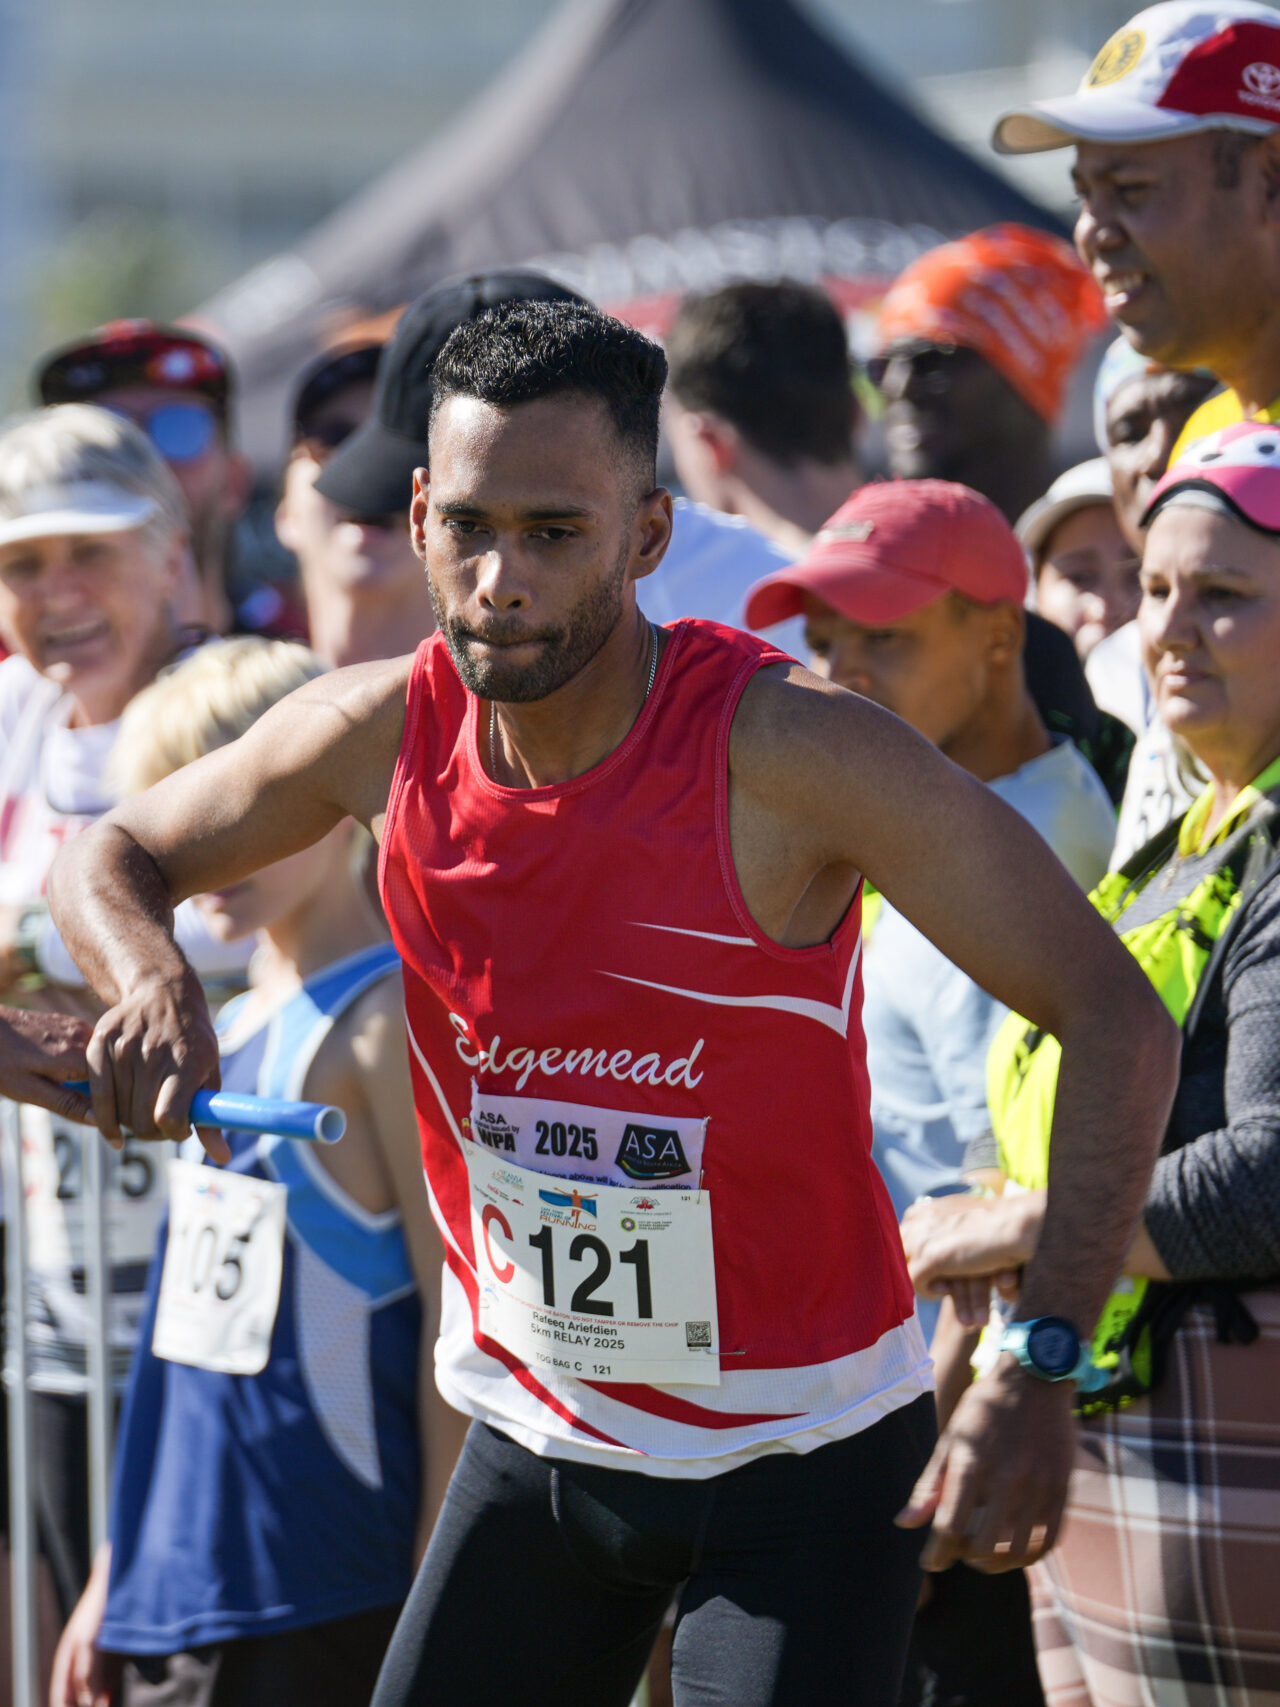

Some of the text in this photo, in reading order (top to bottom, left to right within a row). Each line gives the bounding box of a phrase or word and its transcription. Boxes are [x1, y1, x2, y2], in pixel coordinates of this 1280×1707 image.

[449, 1011, 705, 1090] Edgemead
[477, 1127, 517, 1153] WPA
[480, 1110, 680, 1161] ASA 2025 ASA
[54, 1129, 154, 1199] 25
[539, 1214, 597, 1232] RUNNING
[481, 1203, 516, 1284] C
[528, 1224, 653, 1319] 121
[530, 1322, 625, 1350] 5km RELAY 2025
[532, 1311, 618, 1337] Rafeeq Ariefdien
[536, 1351, 612, 1375] TOG BAG C 121
